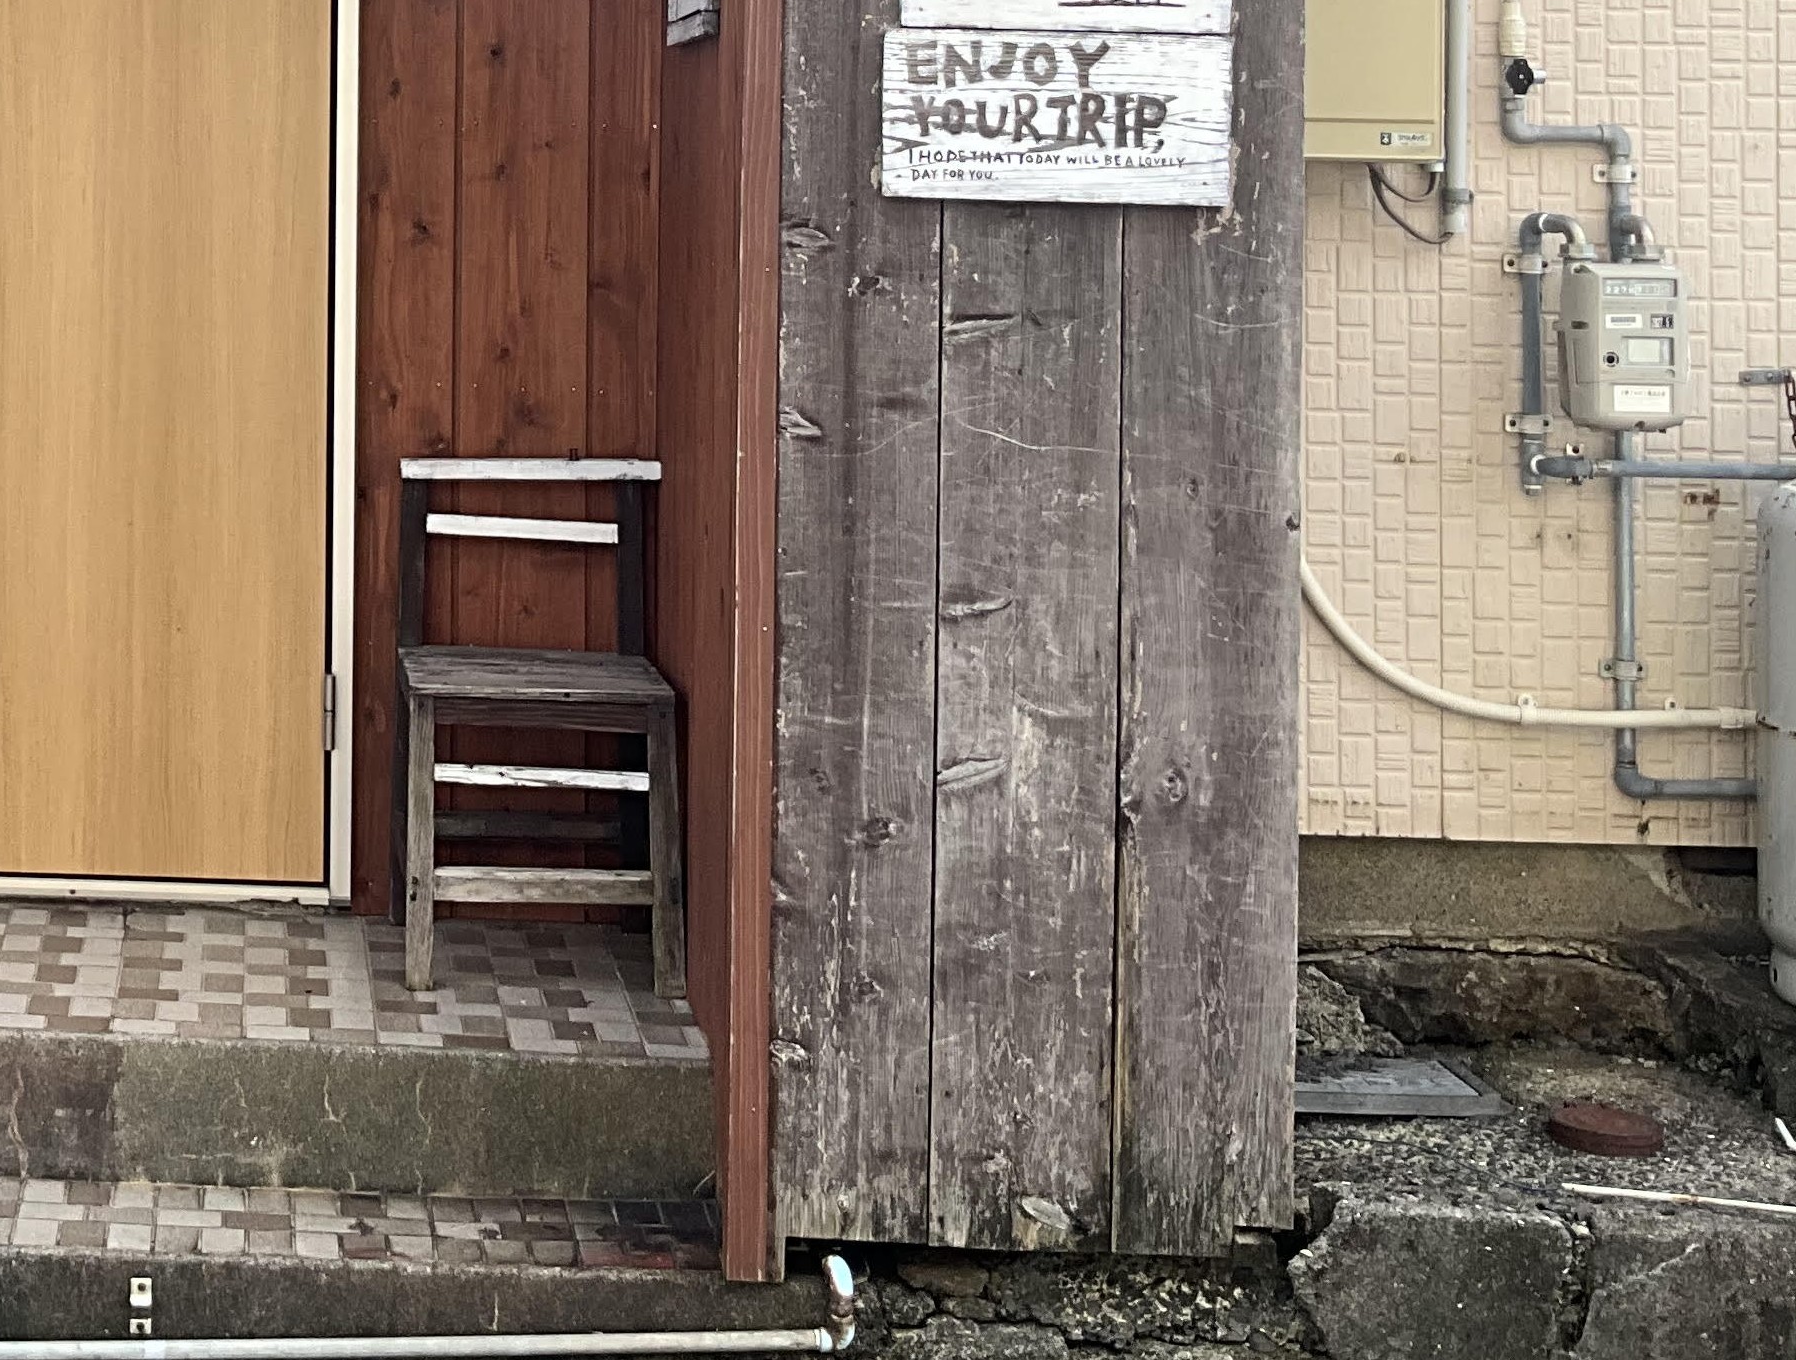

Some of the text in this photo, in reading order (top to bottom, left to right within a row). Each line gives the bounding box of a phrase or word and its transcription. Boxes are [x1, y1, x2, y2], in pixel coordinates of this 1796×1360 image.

[905, 40, 1111, 89] ENJOY
[909, 93, 1042, 143] YOUR
[911, 168, 1000, 182] DAY FOR YOU.
[1015, 152, 1061, 165] TODAY
[1066, 154, 1099, 165] WILL
[1105, 154, 1122, 166] BE
[1125, 155, 1135, 167] A
[1138, 156, 1187, 169] LOVELY
